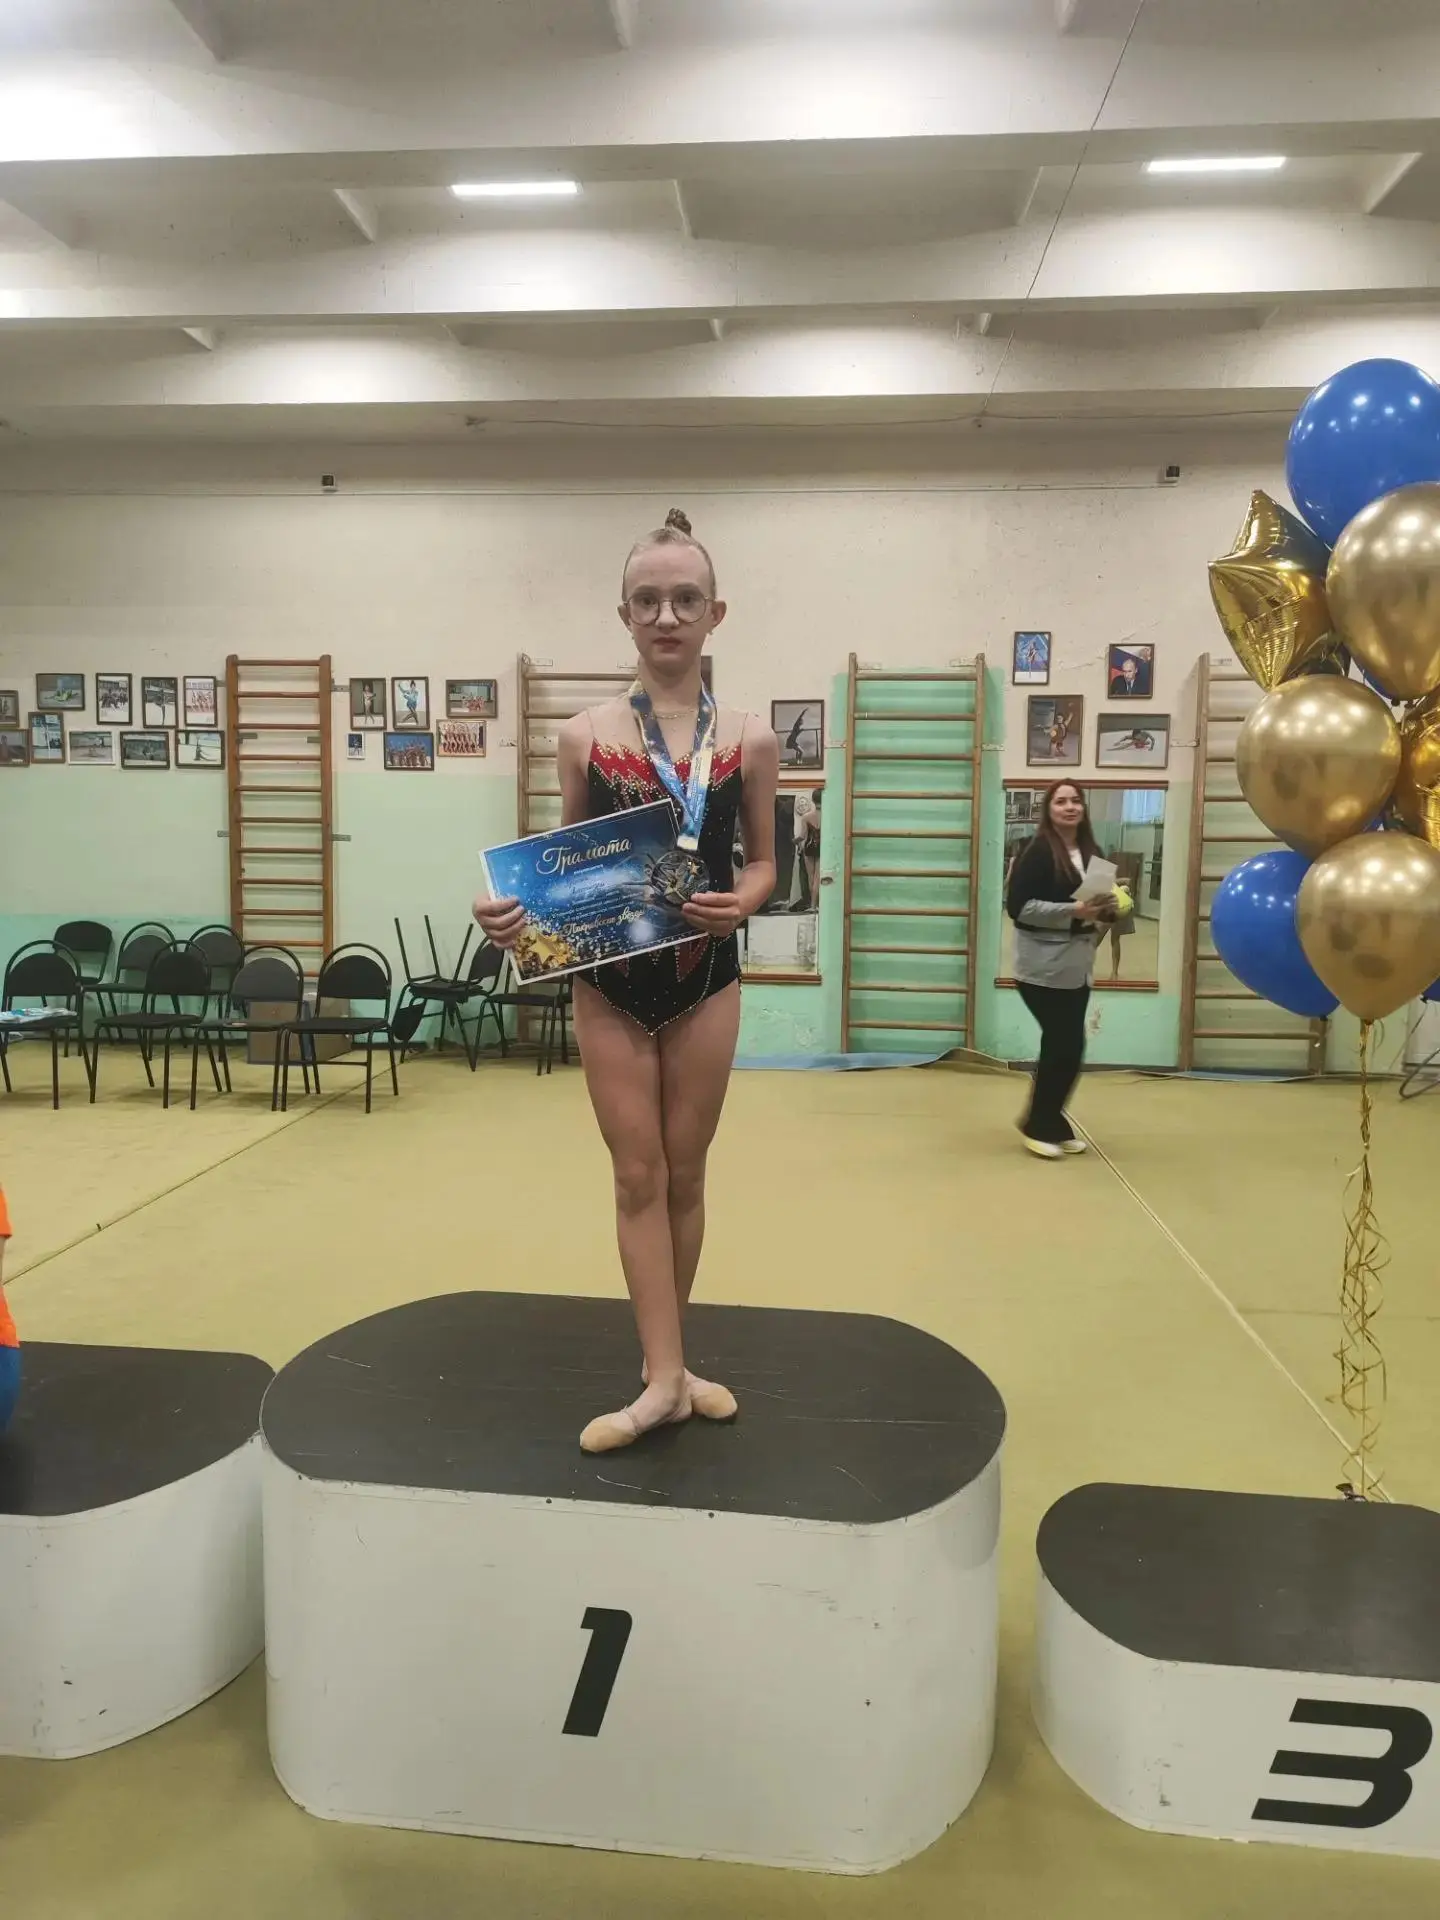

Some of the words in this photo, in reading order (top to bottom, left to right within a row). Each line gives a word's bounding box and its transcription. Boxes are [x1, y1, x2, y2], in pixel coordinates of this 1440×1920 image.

[536, 839, 632, 876] Грамота
[562, 1607, 632, 1737] 1
[1252, 1698, 1432, 1828] 3
